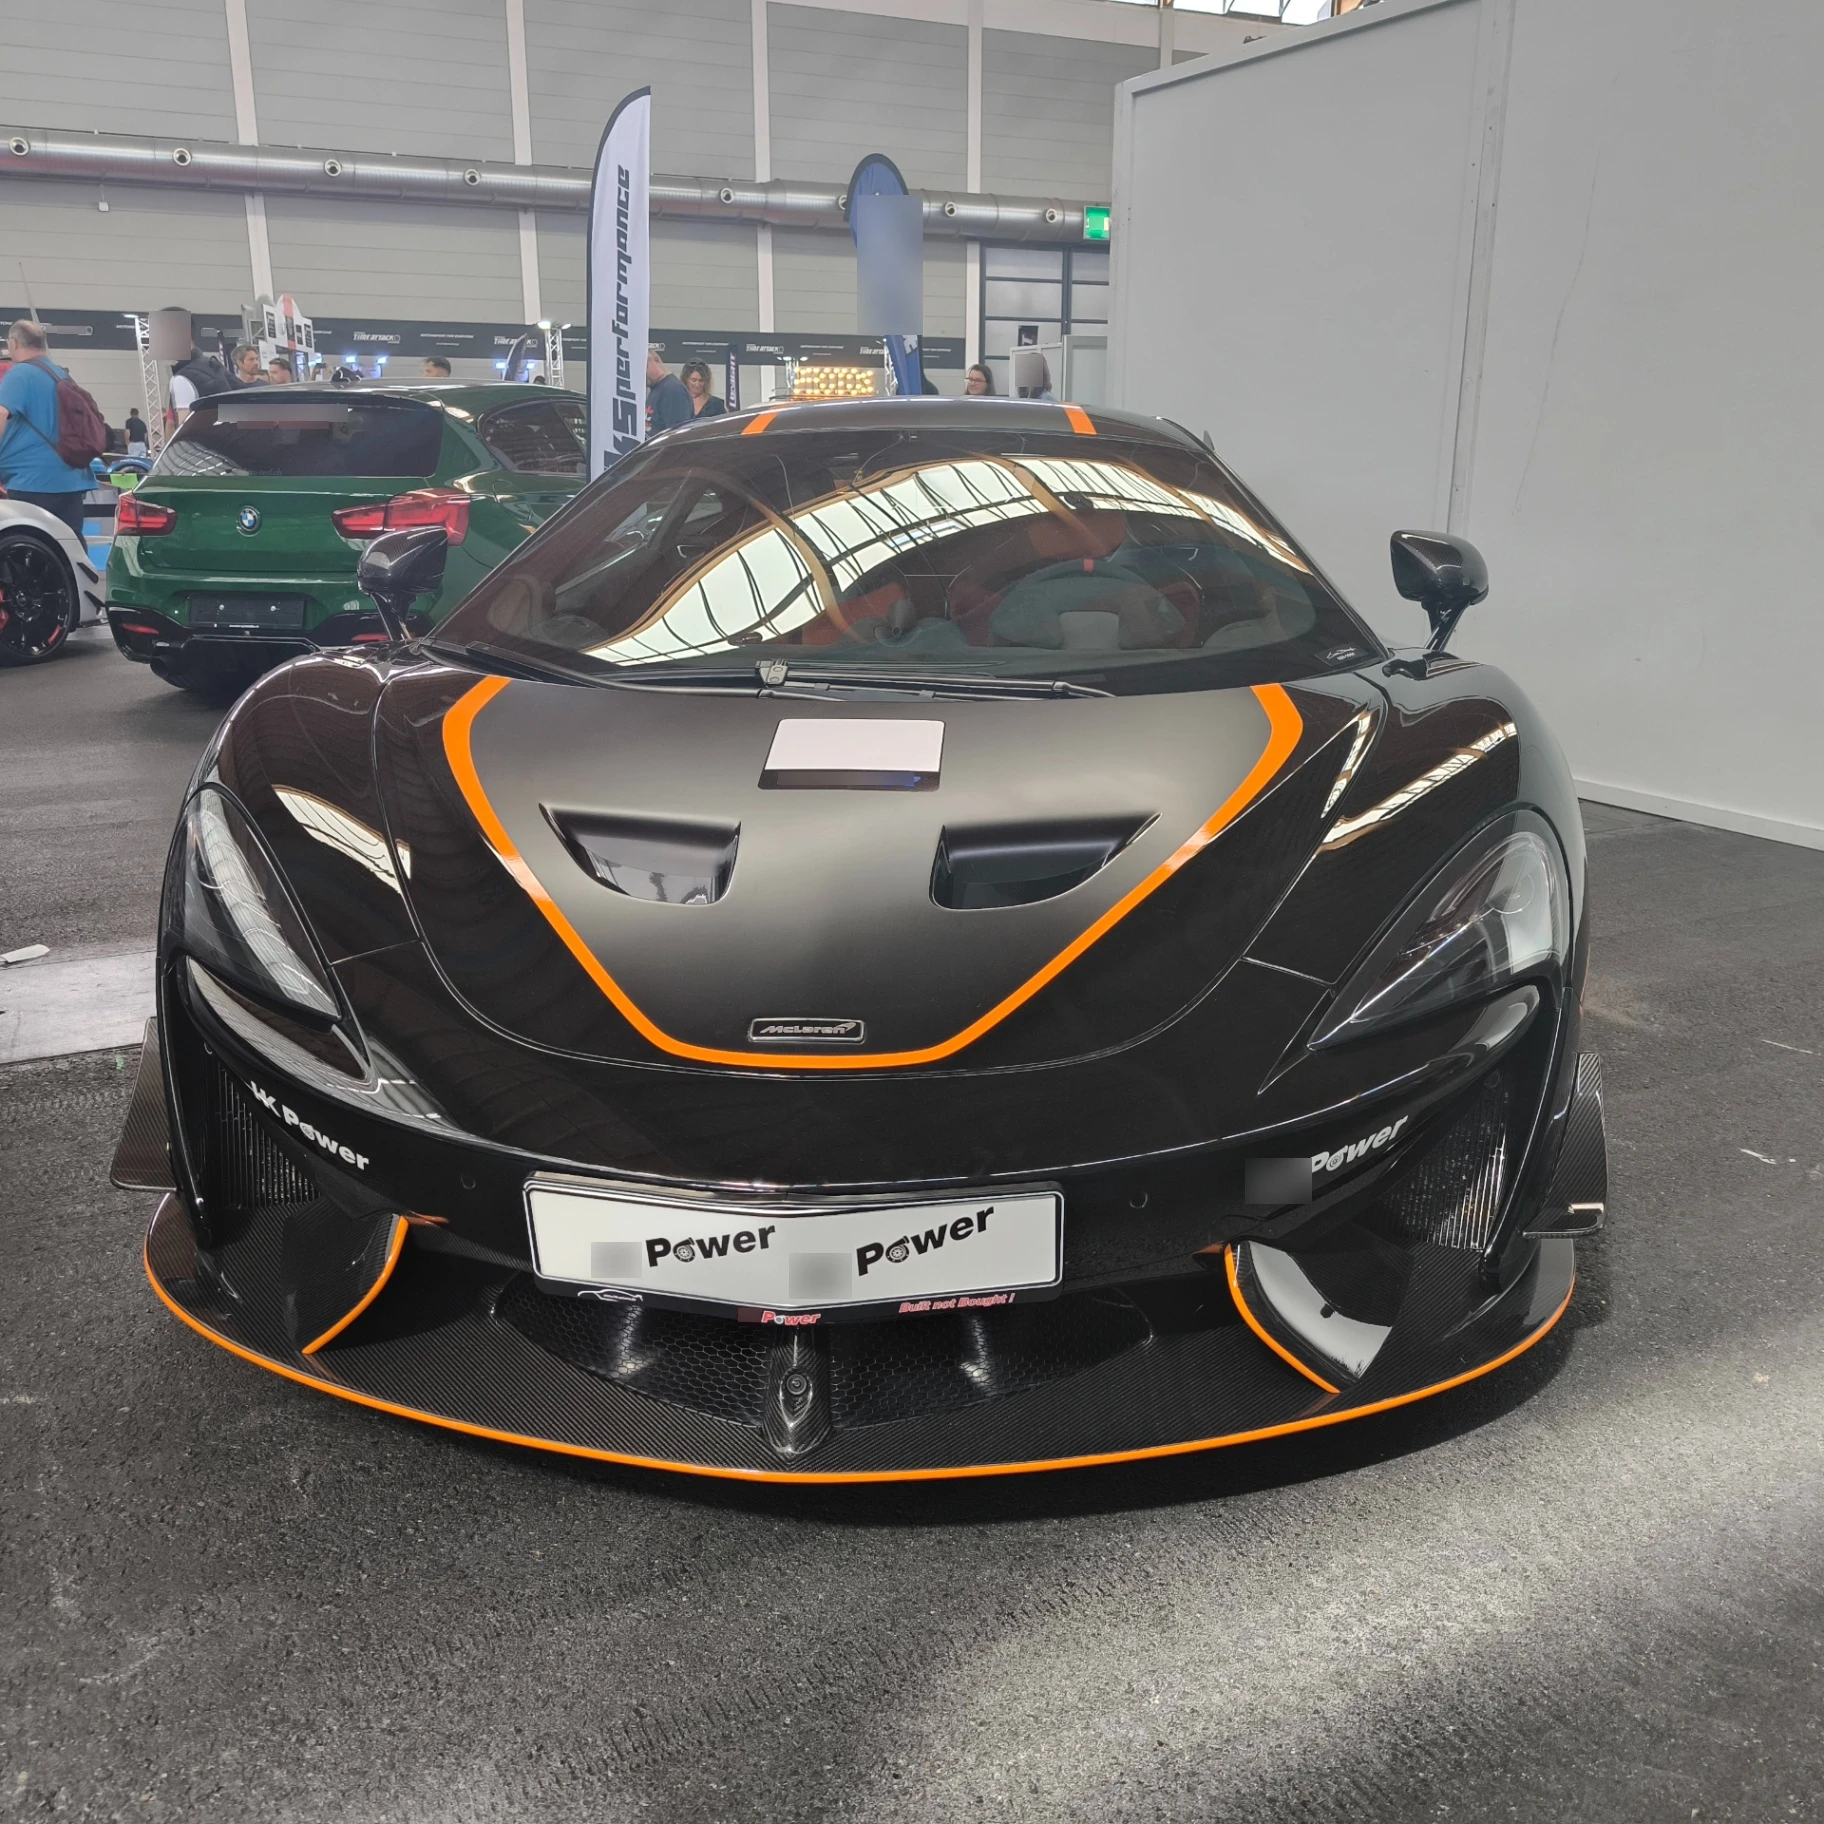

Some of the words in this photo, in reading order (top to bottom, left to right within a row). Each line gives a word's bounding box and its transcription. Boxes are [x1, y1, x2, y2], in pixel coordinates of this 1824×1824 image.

[760, 1025, 847, 1034] McLaren
[282, 1104, 370, 1171] Power
[1311, 1114, 1409, 1173] Power
[645, 1225, 776, 1268] Power
[856, 1206, 995, 1276] Power
[761, 1310, 822, 1326] Power
[899, 1300, 931, 1313] Built
[932, 1299, 957, 1310] not
[957, 1294, 1008, 1308] Bought
